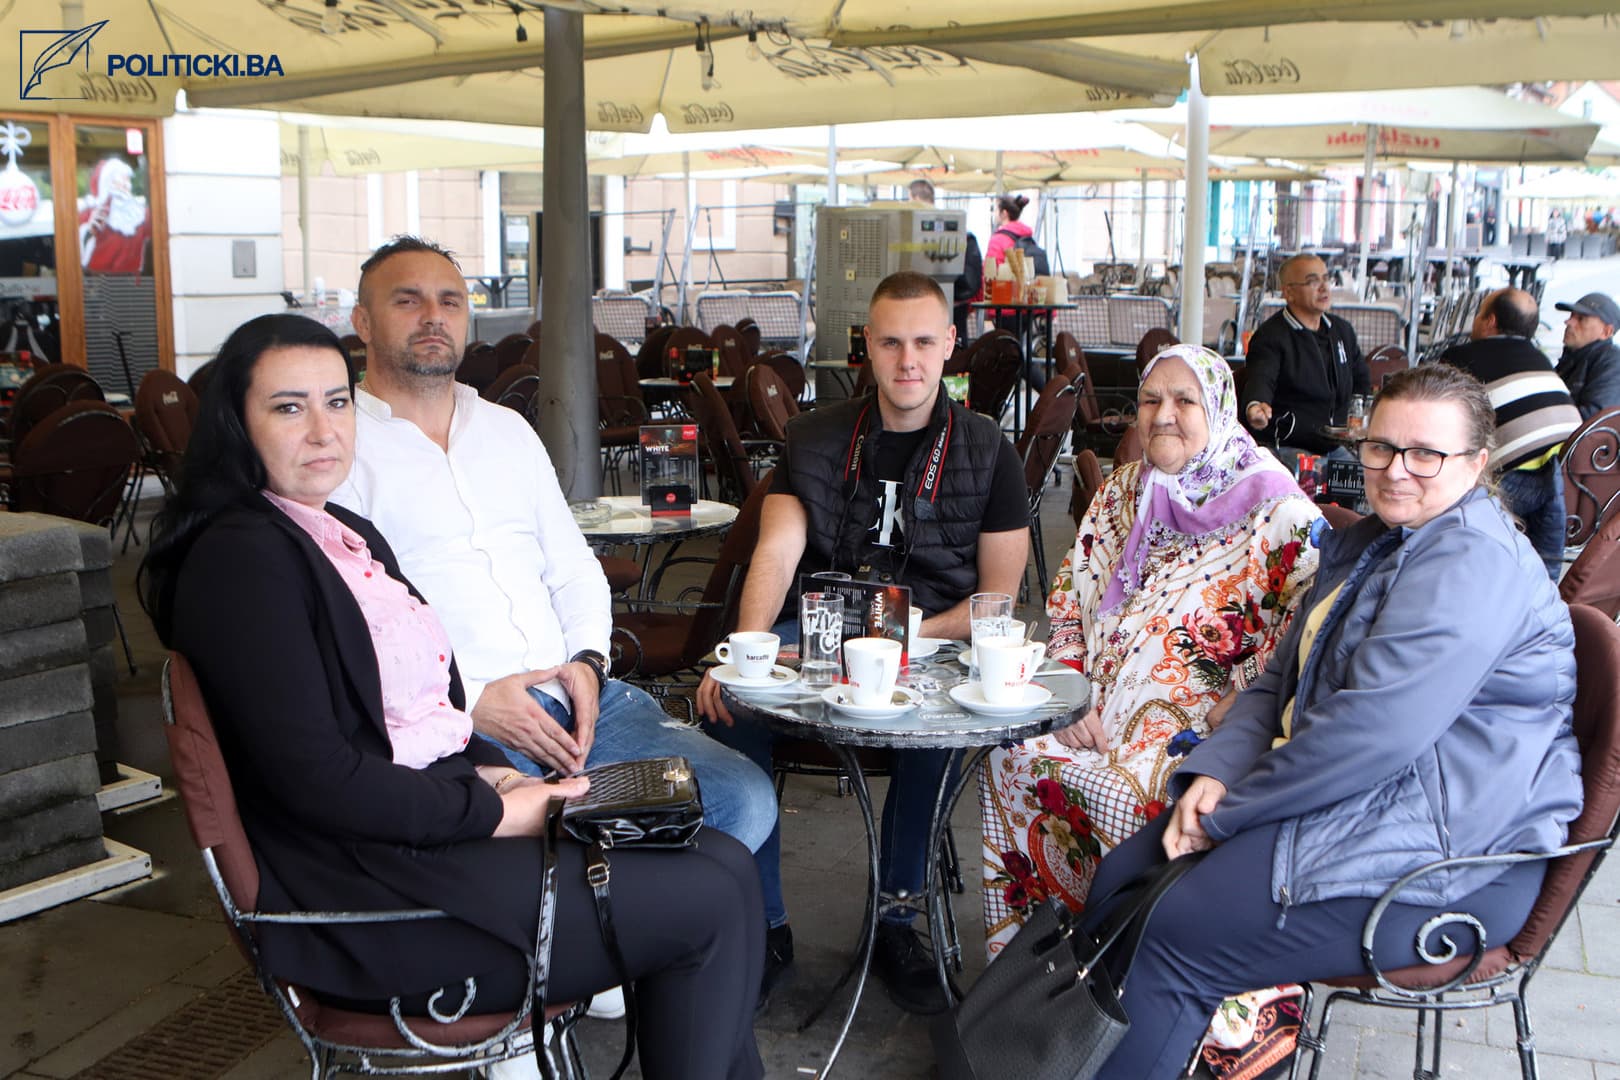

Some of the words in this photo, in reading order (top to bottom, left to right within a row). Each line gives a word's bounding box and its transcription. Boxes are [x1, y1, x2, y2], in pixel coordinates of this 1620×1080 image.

[850, 434, 864, 471] Canon
[924, 463, 937, 490] EOS
[932, 448, 941, 463] 6D
[874, 591, 883, 628] WHITE
